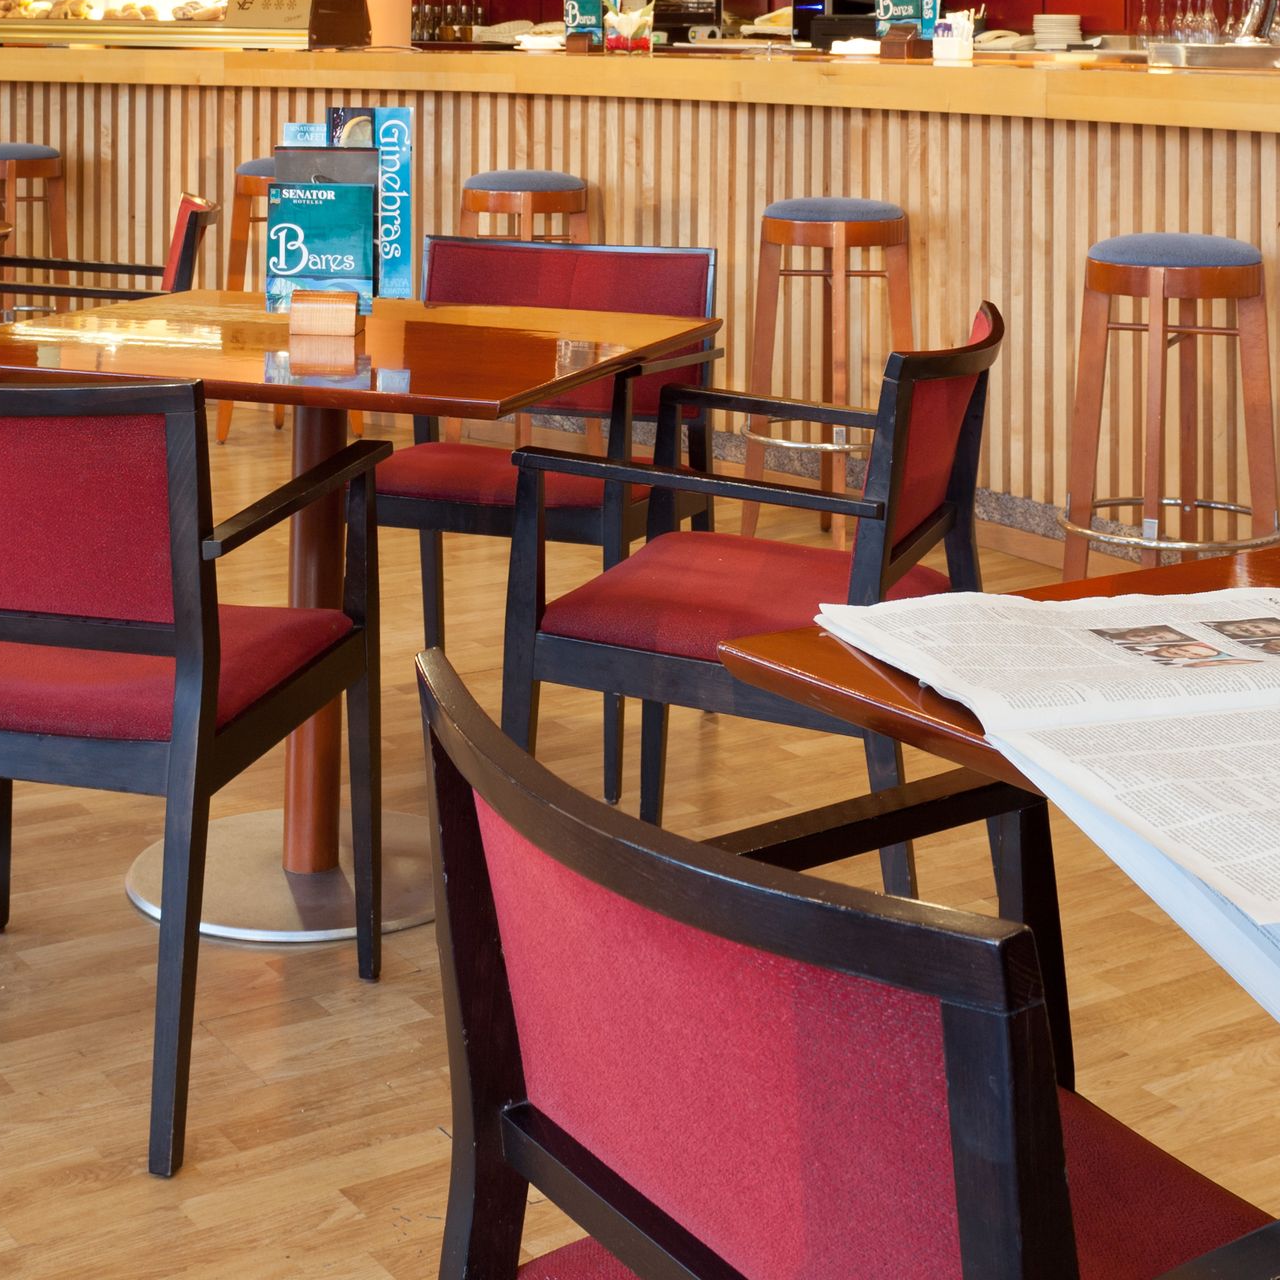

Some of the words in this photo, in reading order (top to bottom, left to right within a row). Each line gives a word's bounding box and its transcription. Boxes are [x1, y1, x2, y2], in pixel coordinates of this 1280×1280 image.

[282, 188, 336, 200] SENATOR
[379, 119, 410, 260] Ginebras
[269, 222, 355, 275] Bares
